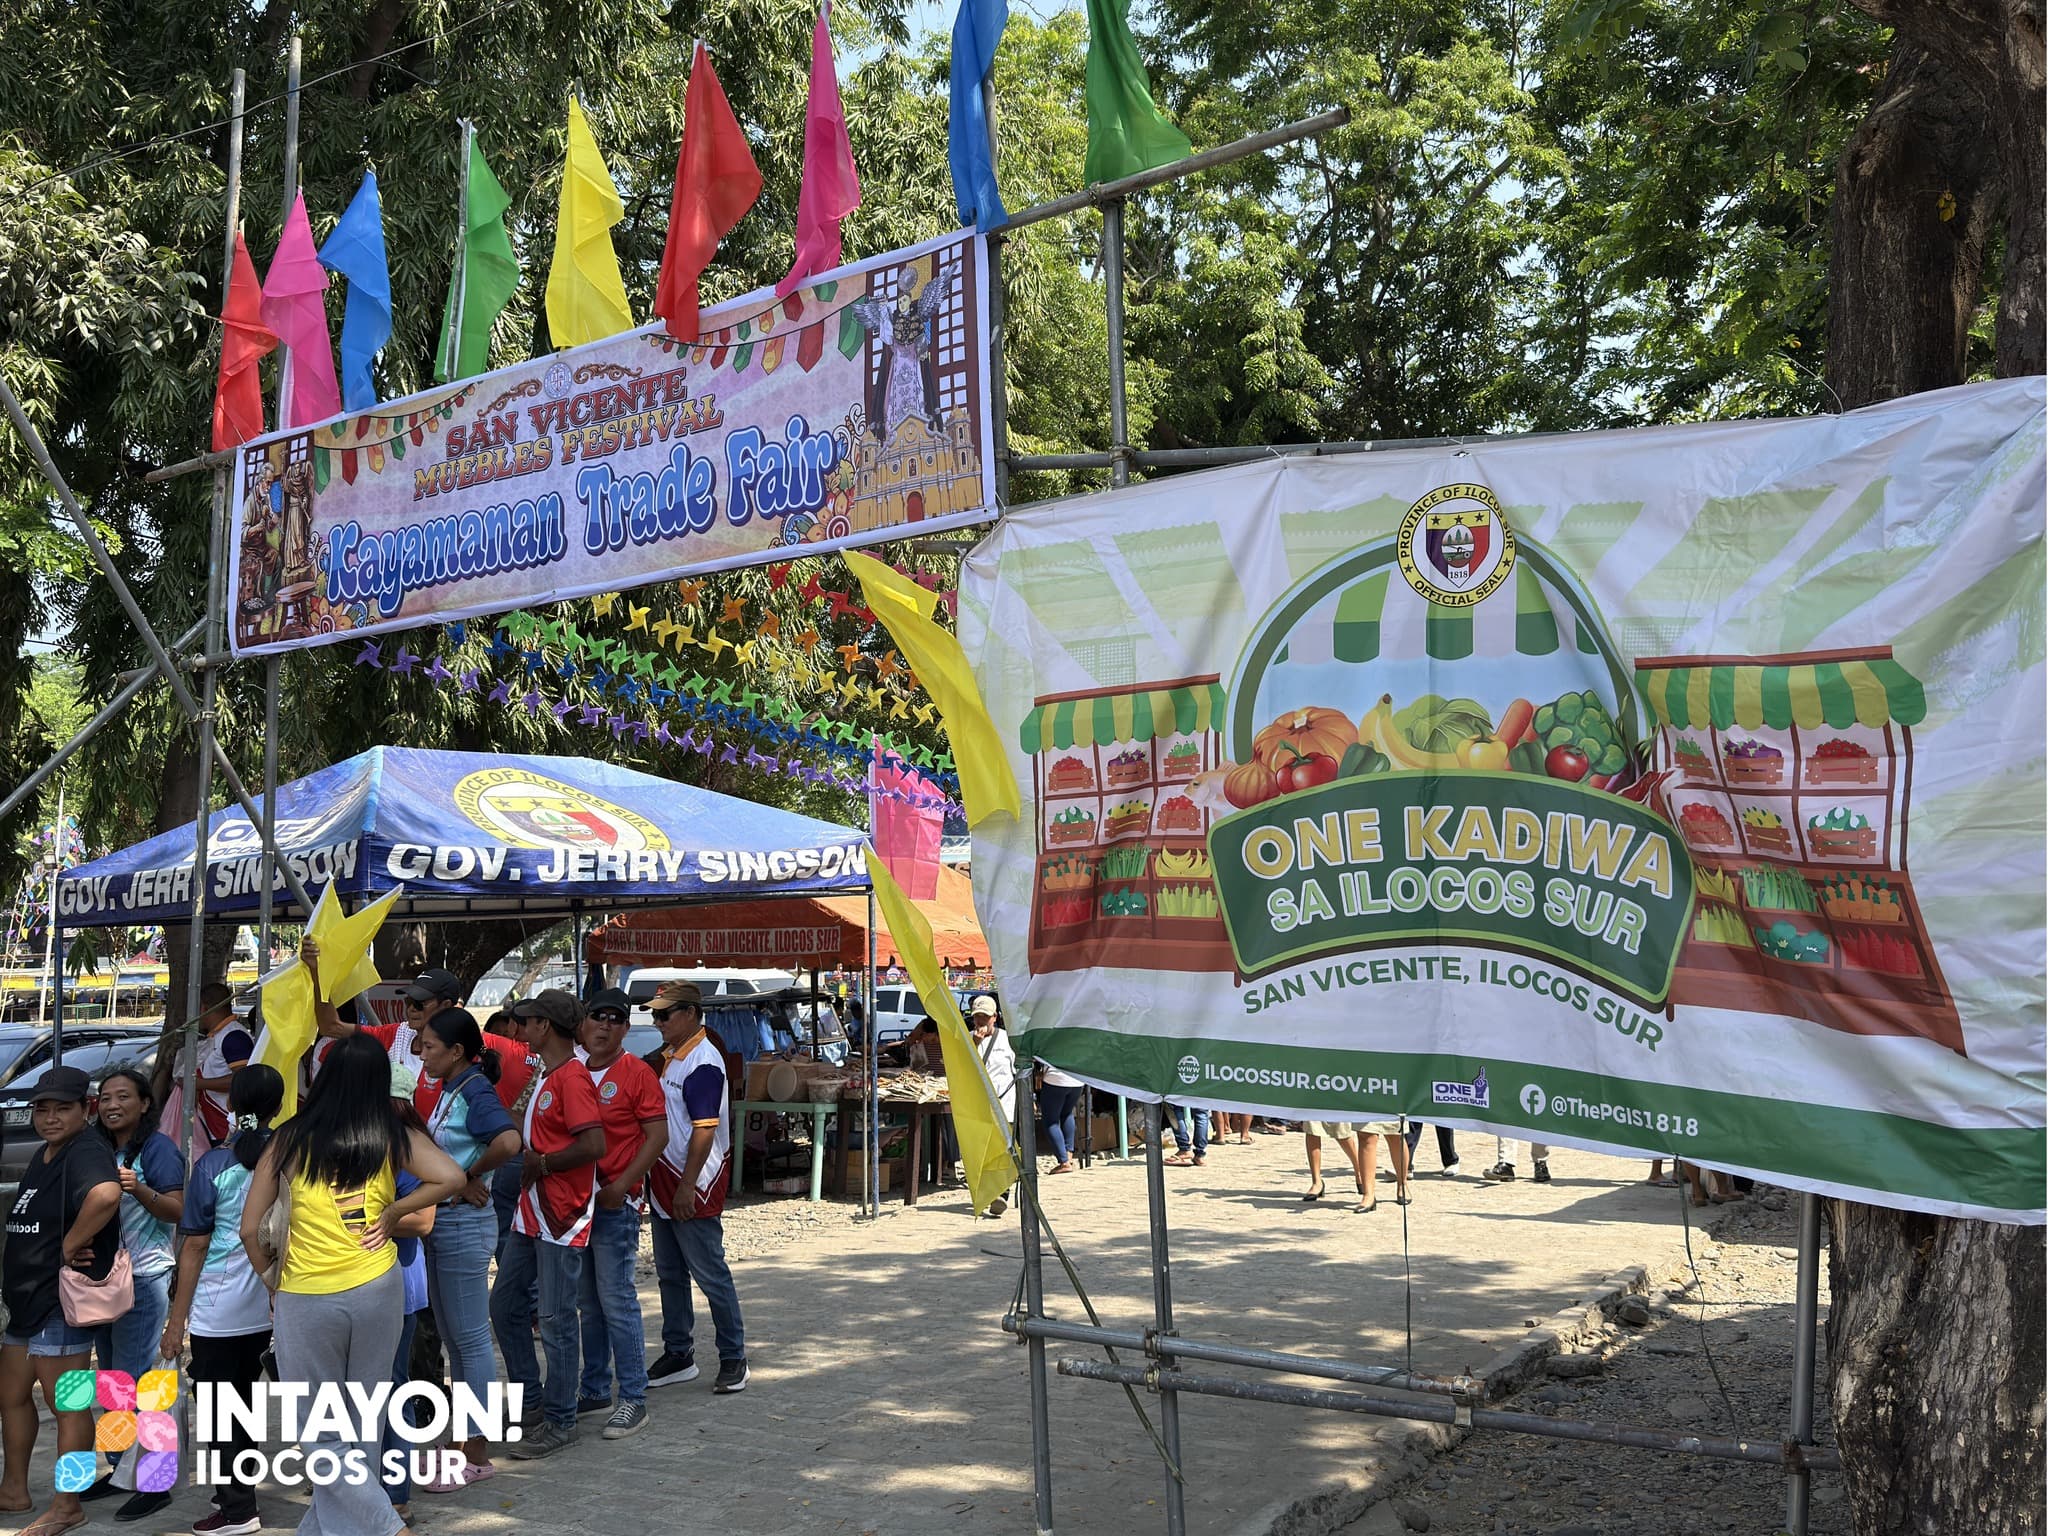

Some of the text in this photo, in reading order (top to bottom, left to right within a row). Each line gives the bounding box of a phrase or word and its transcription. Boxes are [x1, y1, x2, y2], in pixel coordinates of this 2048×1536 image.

[445, 368, 690, 460] SAN VICENTE
[413, 394, 724, 501] MUEBLES FESTIVAL
[326, 413, 838, 619] Kayamanan Trade Fair
[1400, 486, 1514, 559] PROVINCE OF ILOCOS SUR
[1414, 573, 1504, 605] OFFICIAL SEAL
[1450, 570, 1468, 579] 1818
[459, 770, 650, 832] PROVINCE OF ILOCOS SUR
[386, 843, 867, 884] GOV. JERRY SINGSON
[1241, 805, 1673, 899] ONE KADIWA
[58, 875, 117, 917] GOV.
[122, 862, 200, 911] JERR
[1267, 867, 1648, 954] SA ILOCOS SUR
[705, 930, 726, 953] SAN
[775, 929, 813, 952] ILOCOS
[816, 928, 840, 951] SUR
[1243, 956, 1664, 1052] SAN VICENTE, ILOCOS SUR
[1205, 1063, 1398, 1096] ILOCOSSUR.GOV.PH
[1435, 1083, 1472, 1096] ONE
[1435, 1095, 1487, 1106] ILOCOS SUR
[1551, 1095, 1699, 1138] @ThePGIS1818
